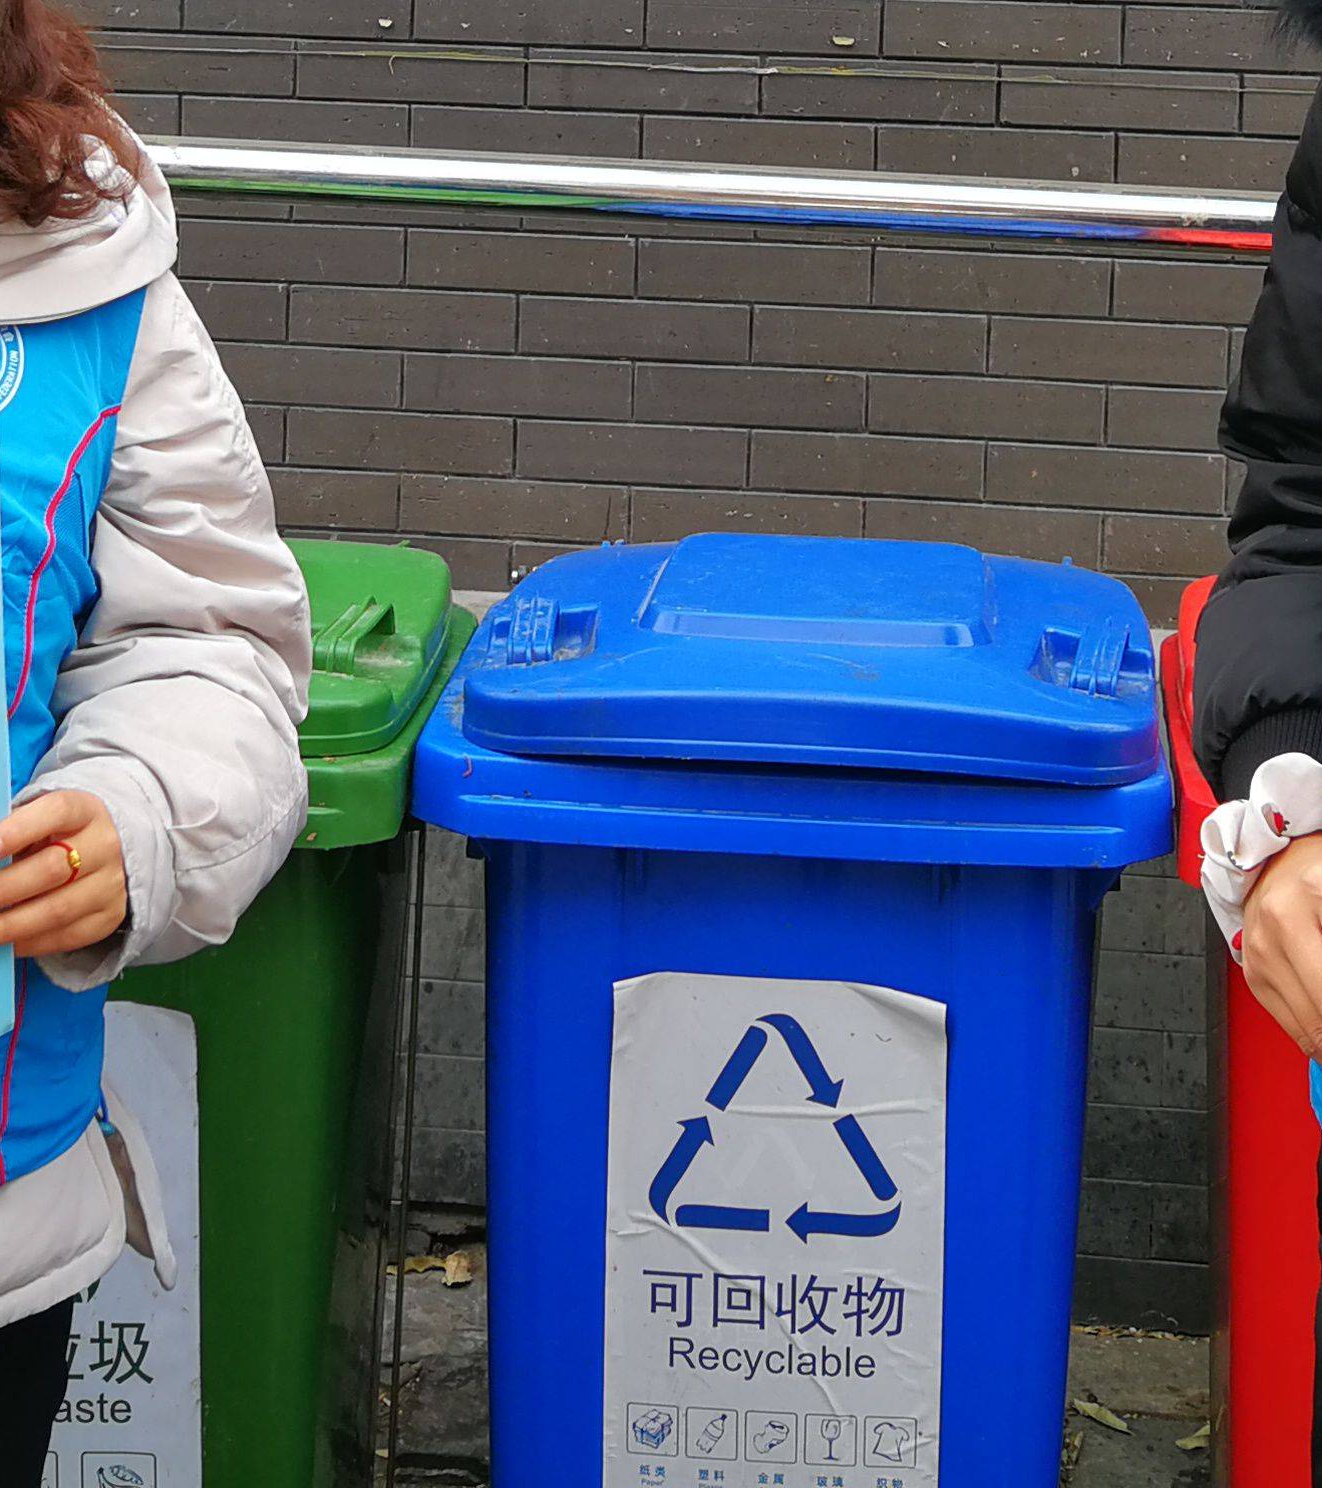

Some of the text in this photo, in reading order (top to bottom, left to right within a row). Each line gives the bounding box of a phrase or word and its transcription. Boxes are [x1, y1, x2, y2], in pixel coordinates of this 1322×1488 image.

[641, 1267, 906, 1338] 可回收物
[667, 1335, 877, 1380] Recyclable
[640, 1465, 666, 1478] 纸类
[698, 1469, 725, 1481] 塑料
[757, 1473, 784, 1485] 金属
